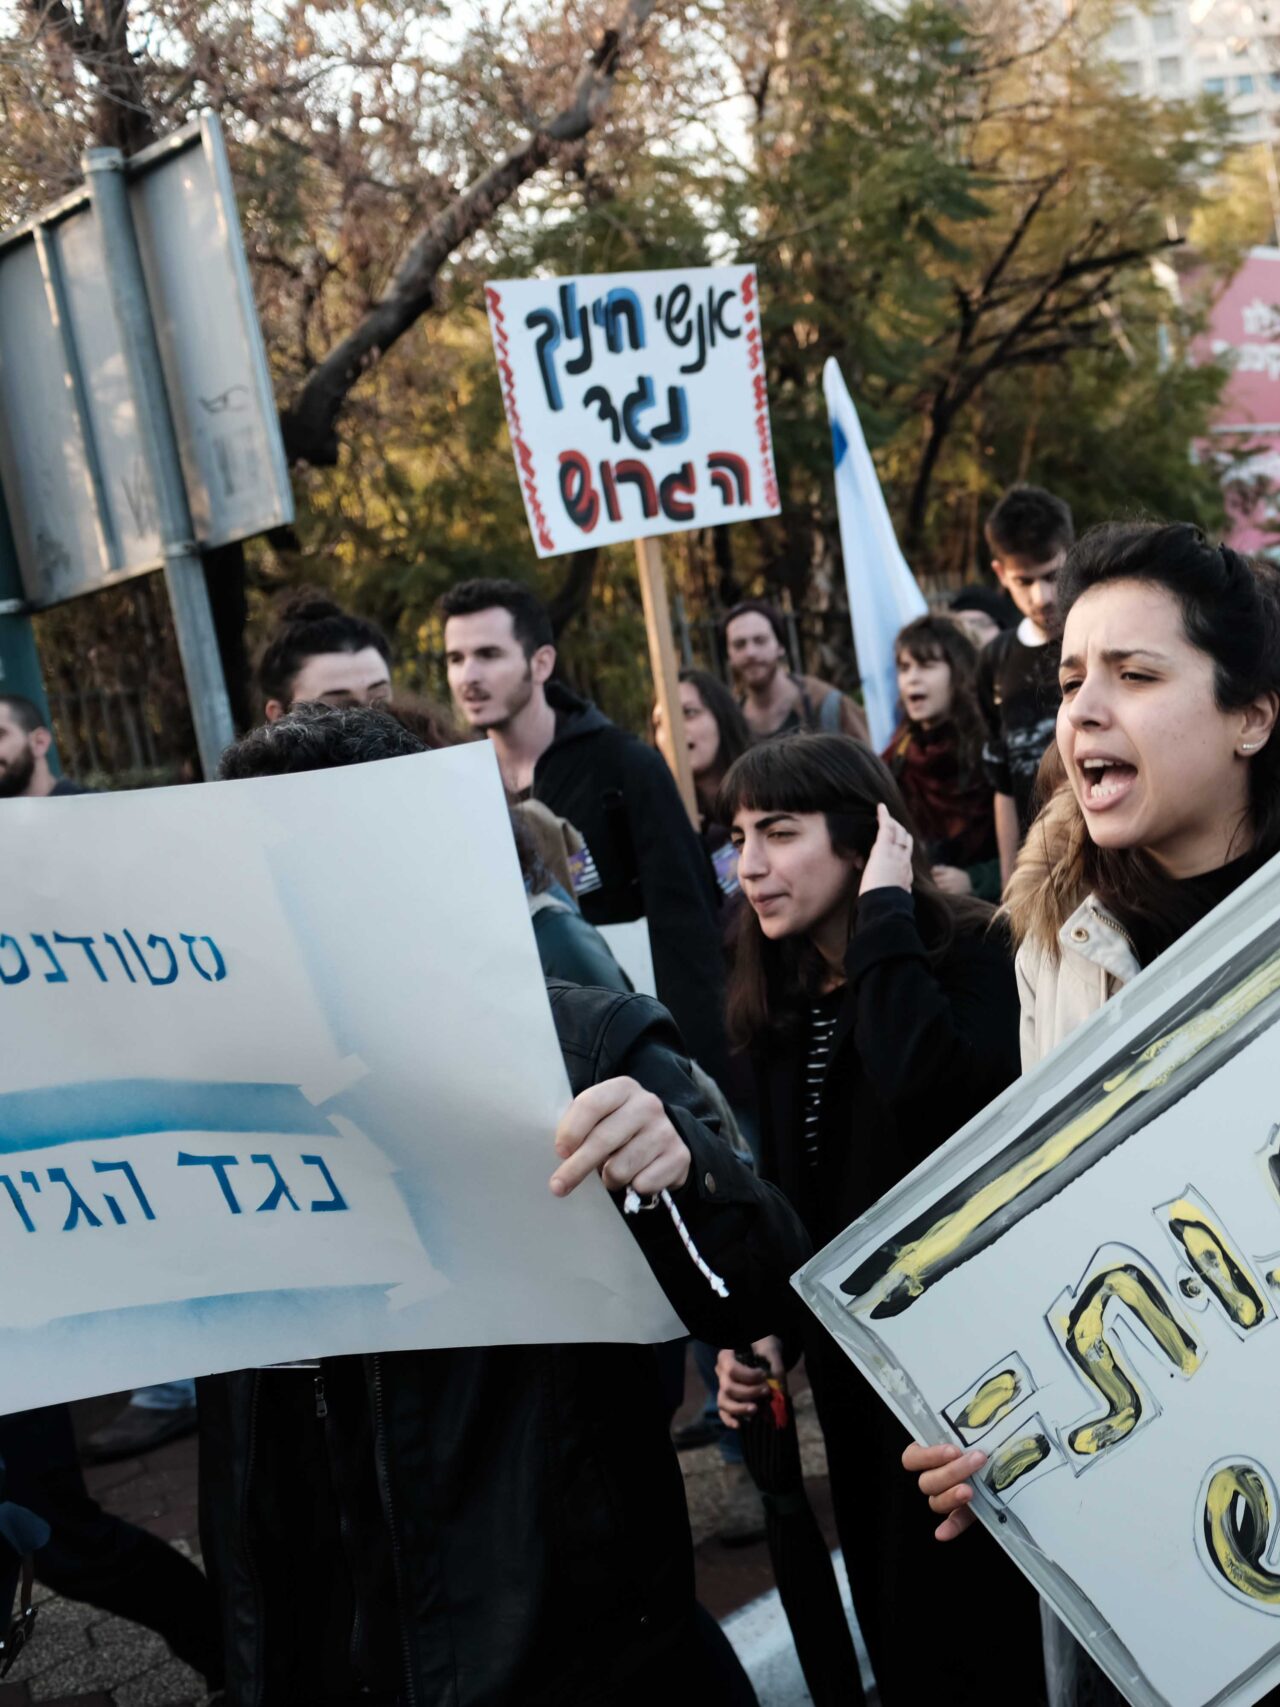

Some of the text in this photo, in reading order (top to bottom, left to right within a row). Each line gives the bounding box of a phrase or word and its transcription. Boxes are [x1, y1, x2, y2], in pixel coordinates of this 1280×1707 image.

[524, 281, 742, 412] אנשי חינוך
[582, 375, 690, 451] נגד
[557, 449, 753, 534] הגרוש
[177, 1151, 349, 1215] נגד
